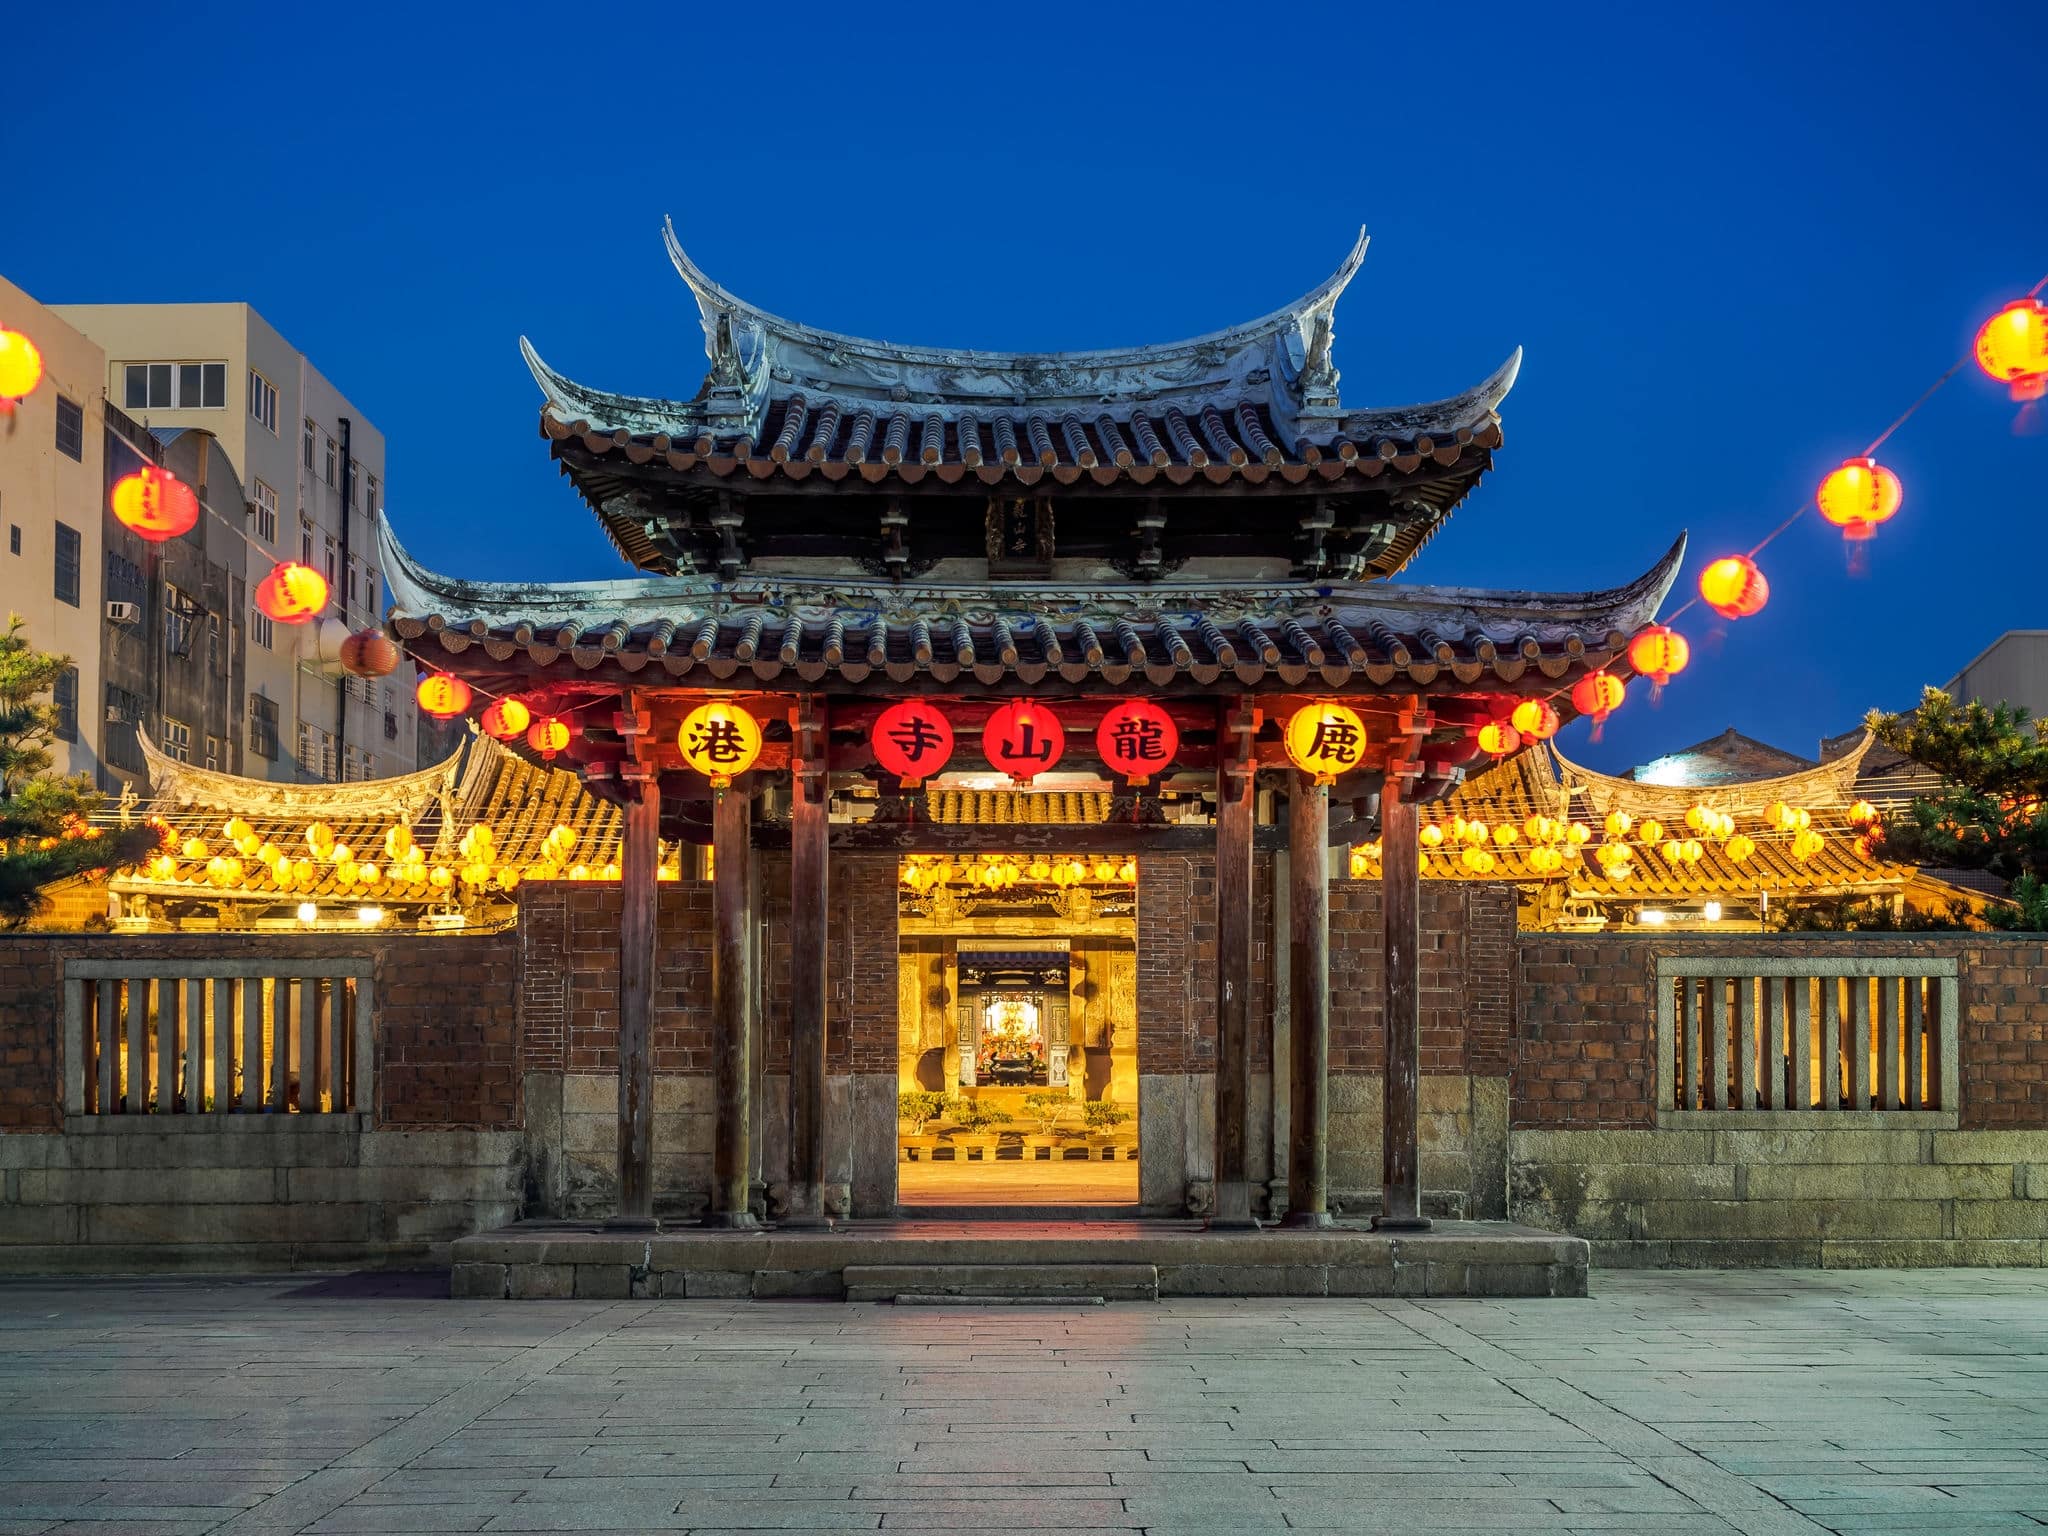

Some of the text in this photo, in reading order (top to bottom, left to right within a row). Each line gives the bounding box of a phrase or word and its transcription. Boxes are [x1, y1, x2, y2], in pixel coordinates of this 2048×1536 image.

[688, 720, 747, 763] 港
[888, 715, 943, 762] 寺
[1000, 723, 1053, 762] 山
[1110, 716, 1167, 760] 龍
[1306, 716, 1359, 764] 鹿
